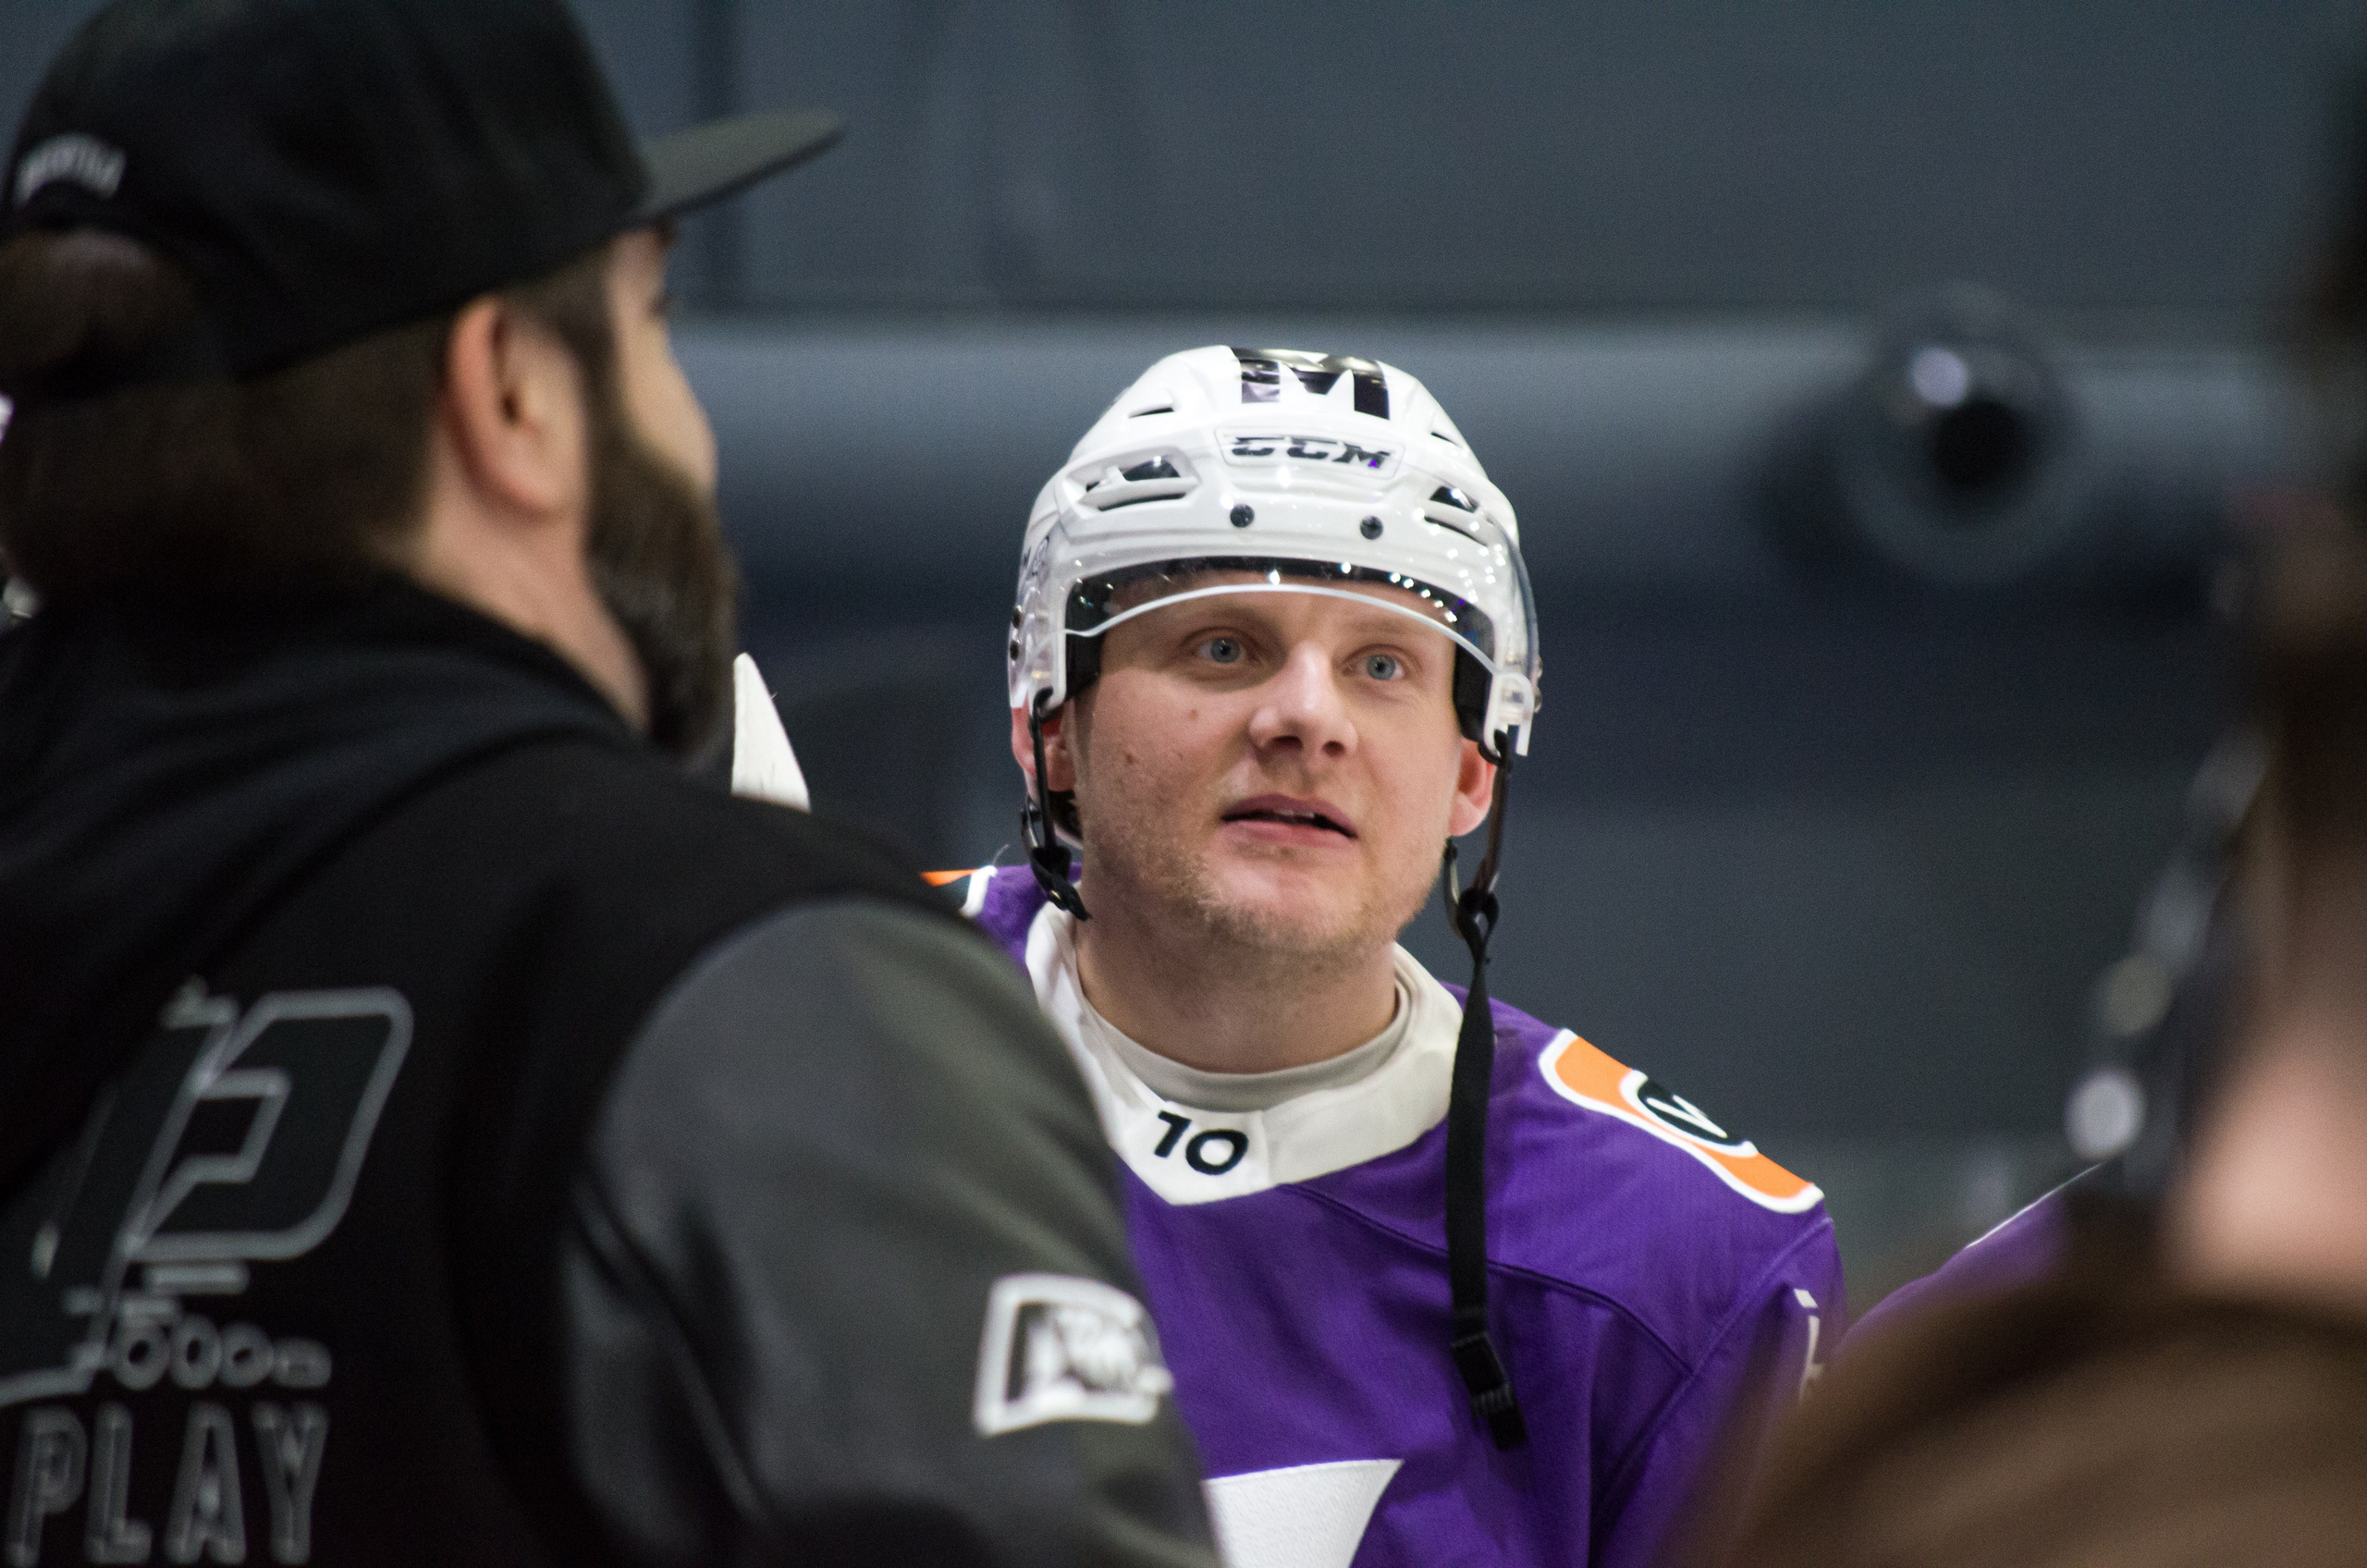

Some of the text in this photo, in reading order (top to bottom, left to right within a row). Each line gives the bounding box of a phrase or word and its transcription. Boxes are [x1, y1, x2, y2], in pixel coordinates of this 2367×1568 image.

[1231, 435, 1392, 469] CCM
[1154, 1109, 1249, 1176] 10
[5, 1399, 330, 1566] PLAY
